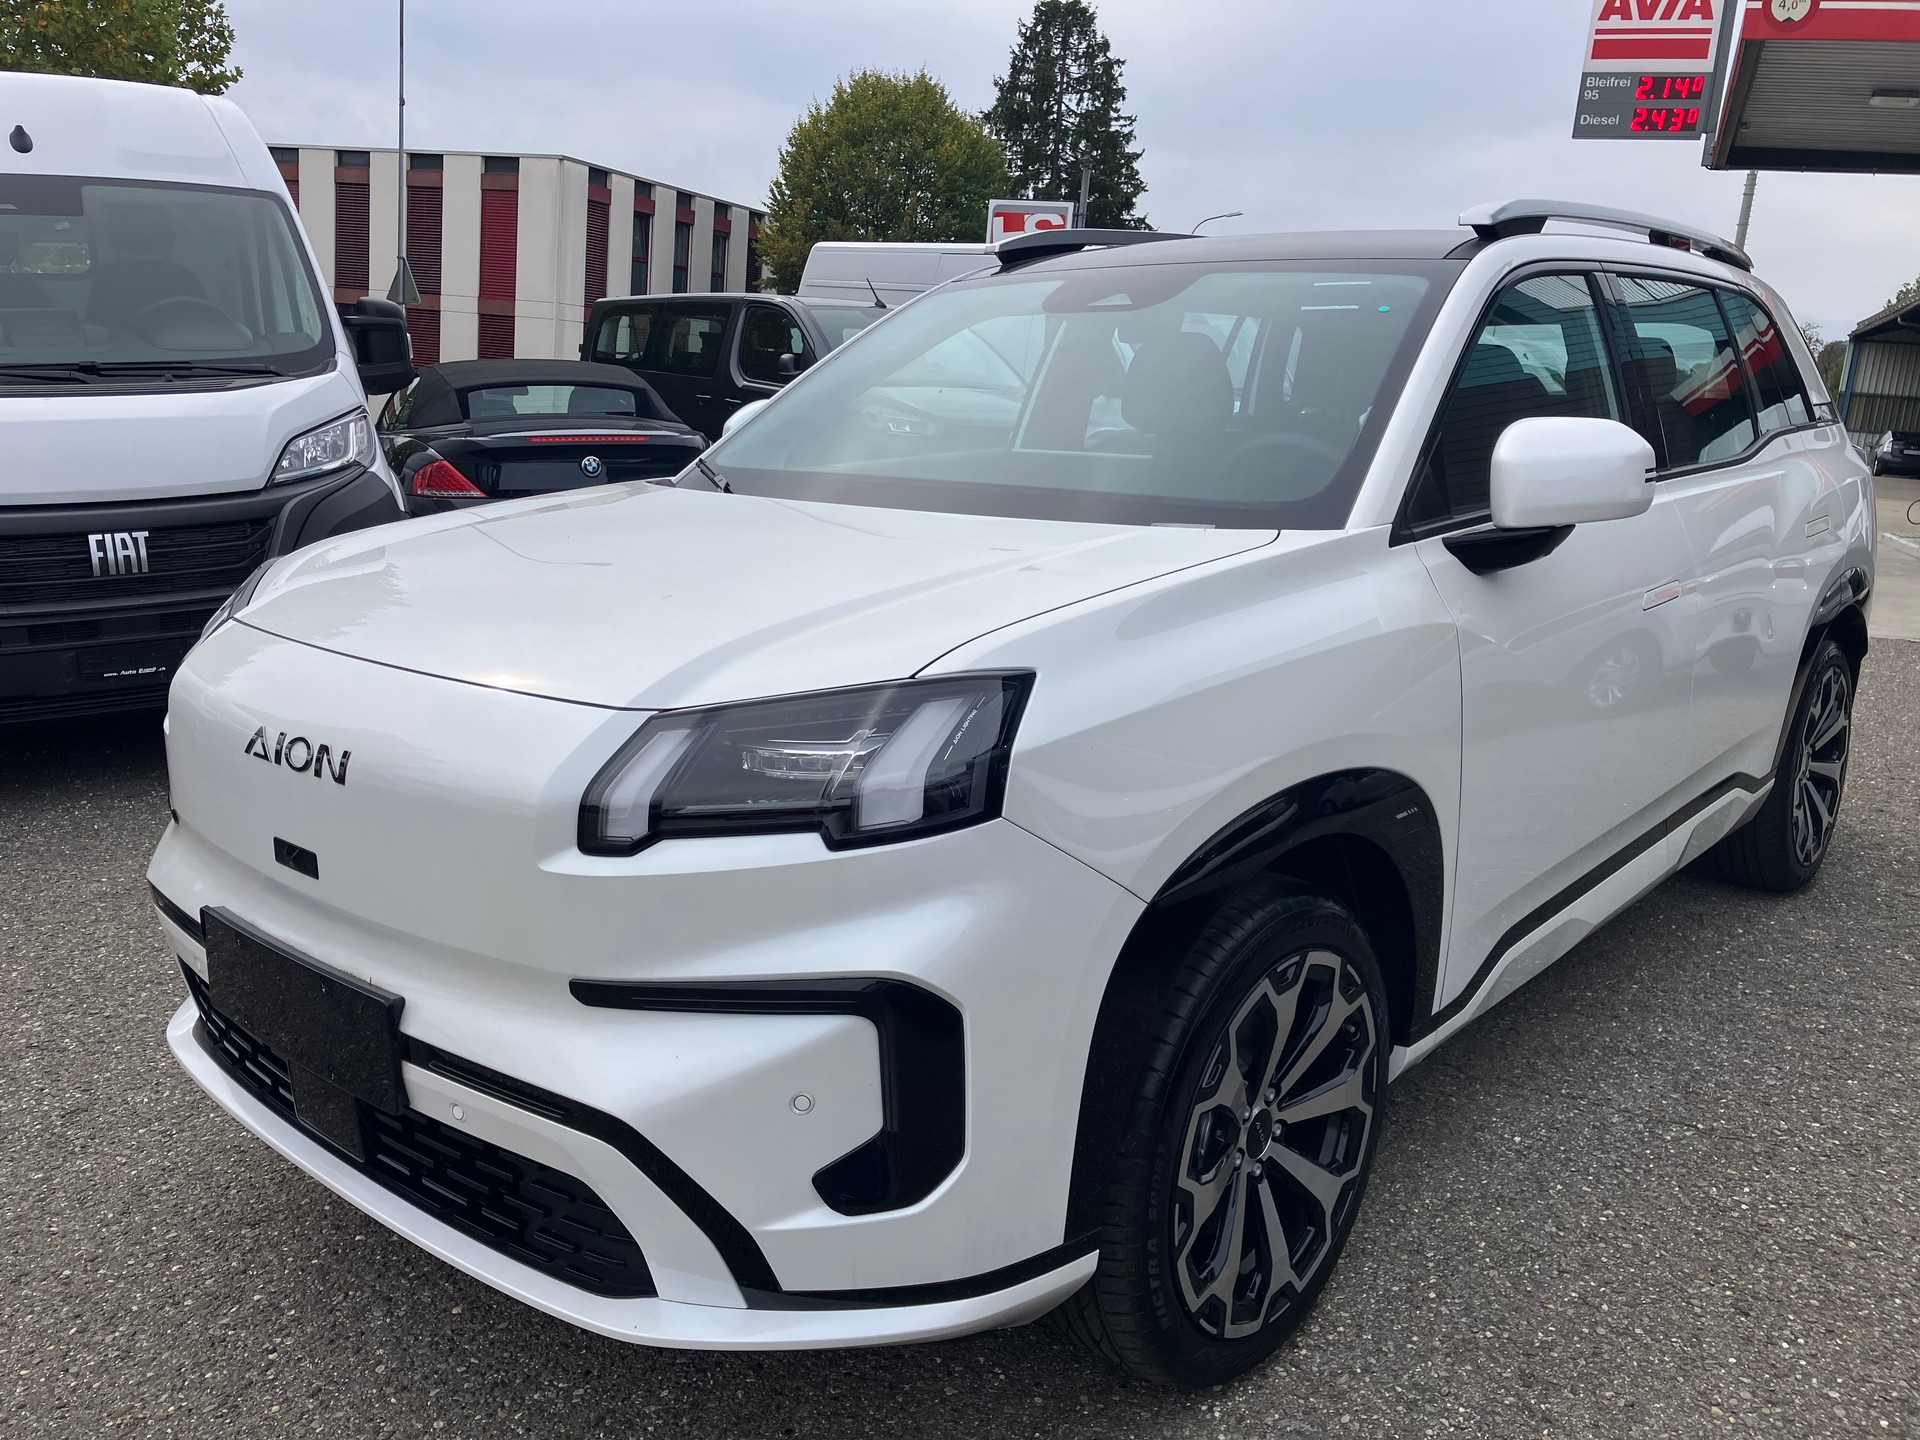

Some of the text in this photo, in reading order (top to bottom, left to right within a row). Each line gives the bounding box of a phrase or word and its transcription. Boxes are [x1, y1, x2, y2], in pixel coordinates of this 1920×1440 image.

[1597, 0, 1714, 21] AVIA
[1586, 76, 1631, 88] Bleifrei
[1583, 90, 1600, 101] 95
[1579, 115, 1620, 126] Diesel
[88, 531, 149, 576] FIAT
[953, 709, 977, 744] AION LIGHTING
[244, 725, 351, 786] AION
